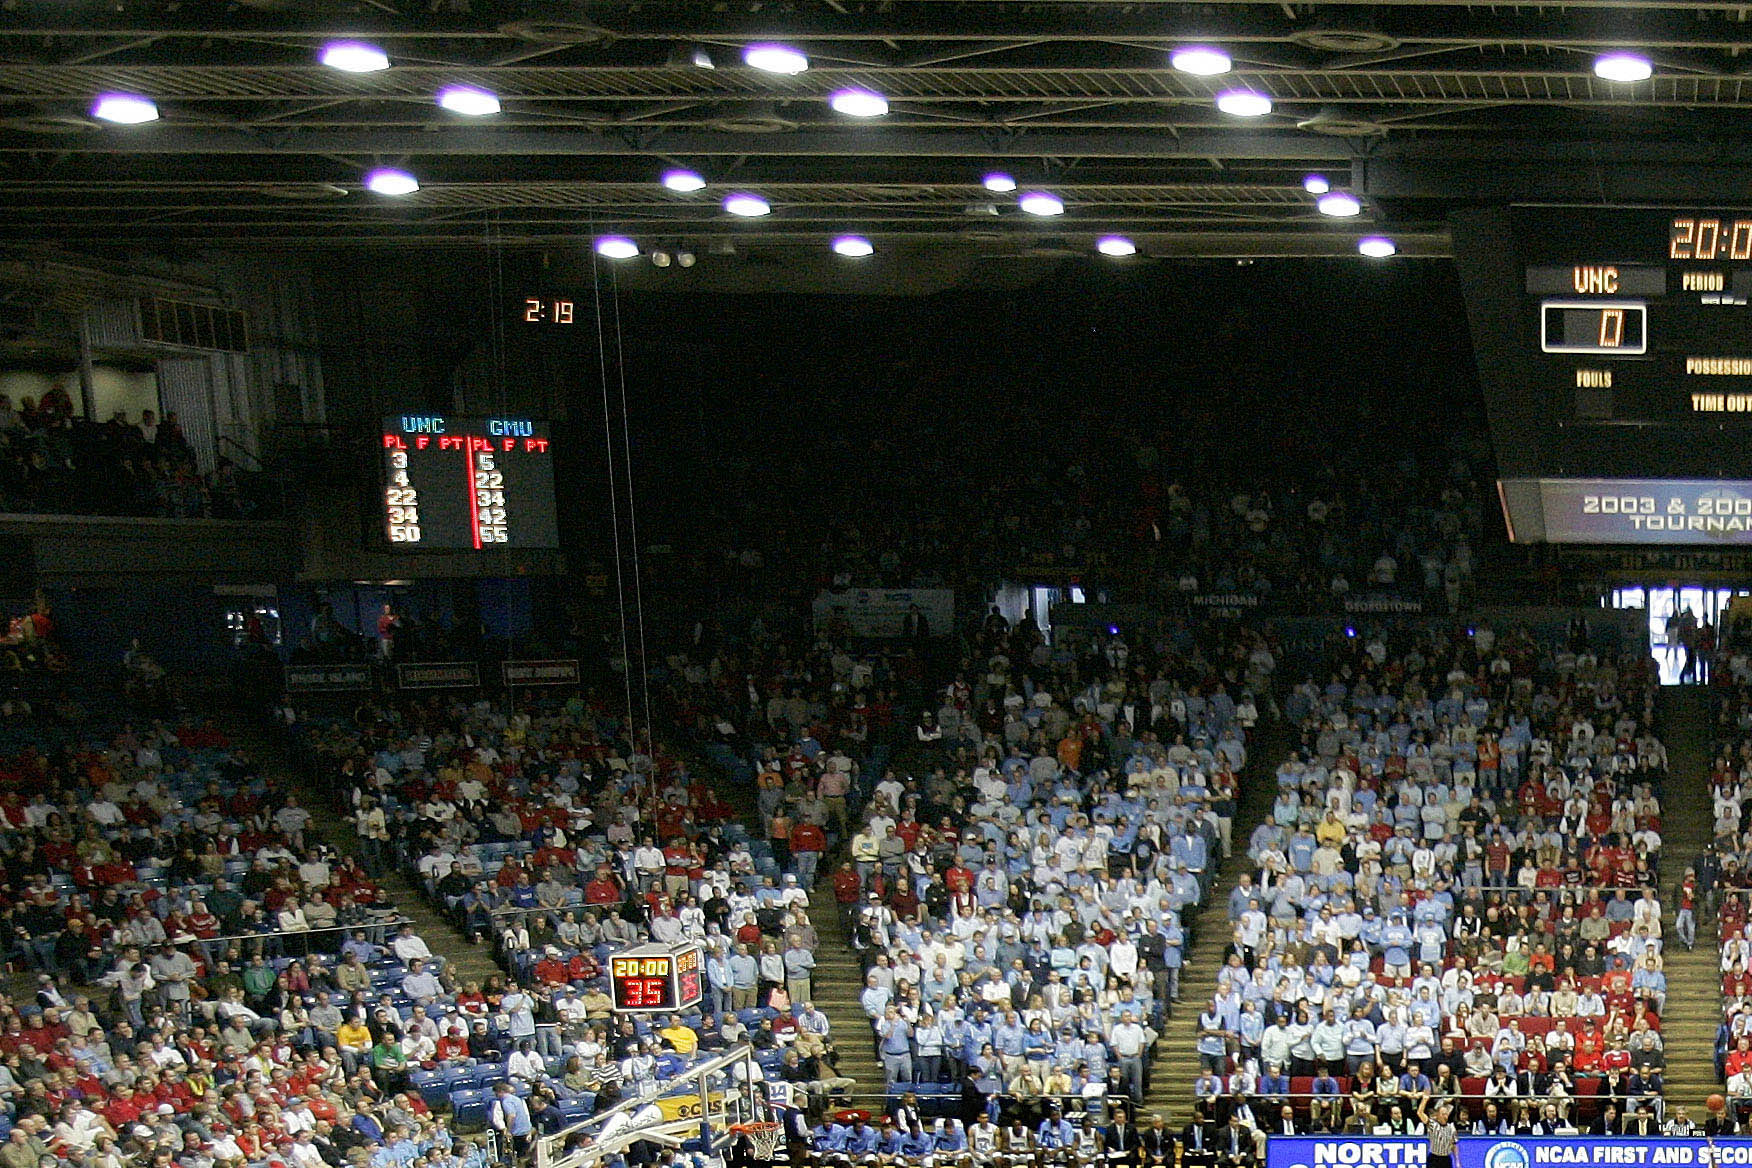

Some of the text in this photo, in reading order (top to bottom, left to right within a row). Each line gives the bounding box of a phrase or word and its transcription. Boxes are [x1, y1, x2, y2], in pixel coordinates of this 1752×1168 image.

[1573, 266, 1619, 294] UNC
[1682, 273, 1723, 291] PERIOD
[526, 300, 573, 323] 2:19
[1599, 310, 1624, 348] 0
[1576, 369, 1612, 388] FOULS
[1692, 393, 1752, 412] TIME OUT
[392, 452, 408, 468] 3
[479, 453, 494, 470] 5
[394, 470, 409, 486] 4
[476, 472, 504, 489] 22
[387, 489, 418, 506] 22
[477, 490, 505, 507] 34
[1583, 495, 1656, 515] 2003
[1667, 498, 1686, 515] &
[388, 507, 419, 524] 34
[478, 508, 507, 525] 42
[389, 525, 421, 542] 50
[479, 526, 508, 543] 55
[615, 960, 669, 977] 20:00
[626, 981, 662, 1005] 35
[1314, 1143, 1426, 1164] NORTH
[1535, 1146, 1588, 1163] NCAA
[1592, 1146, 1649, 1164] FIRST
[1652, 1147, 1693, 1164] AND
